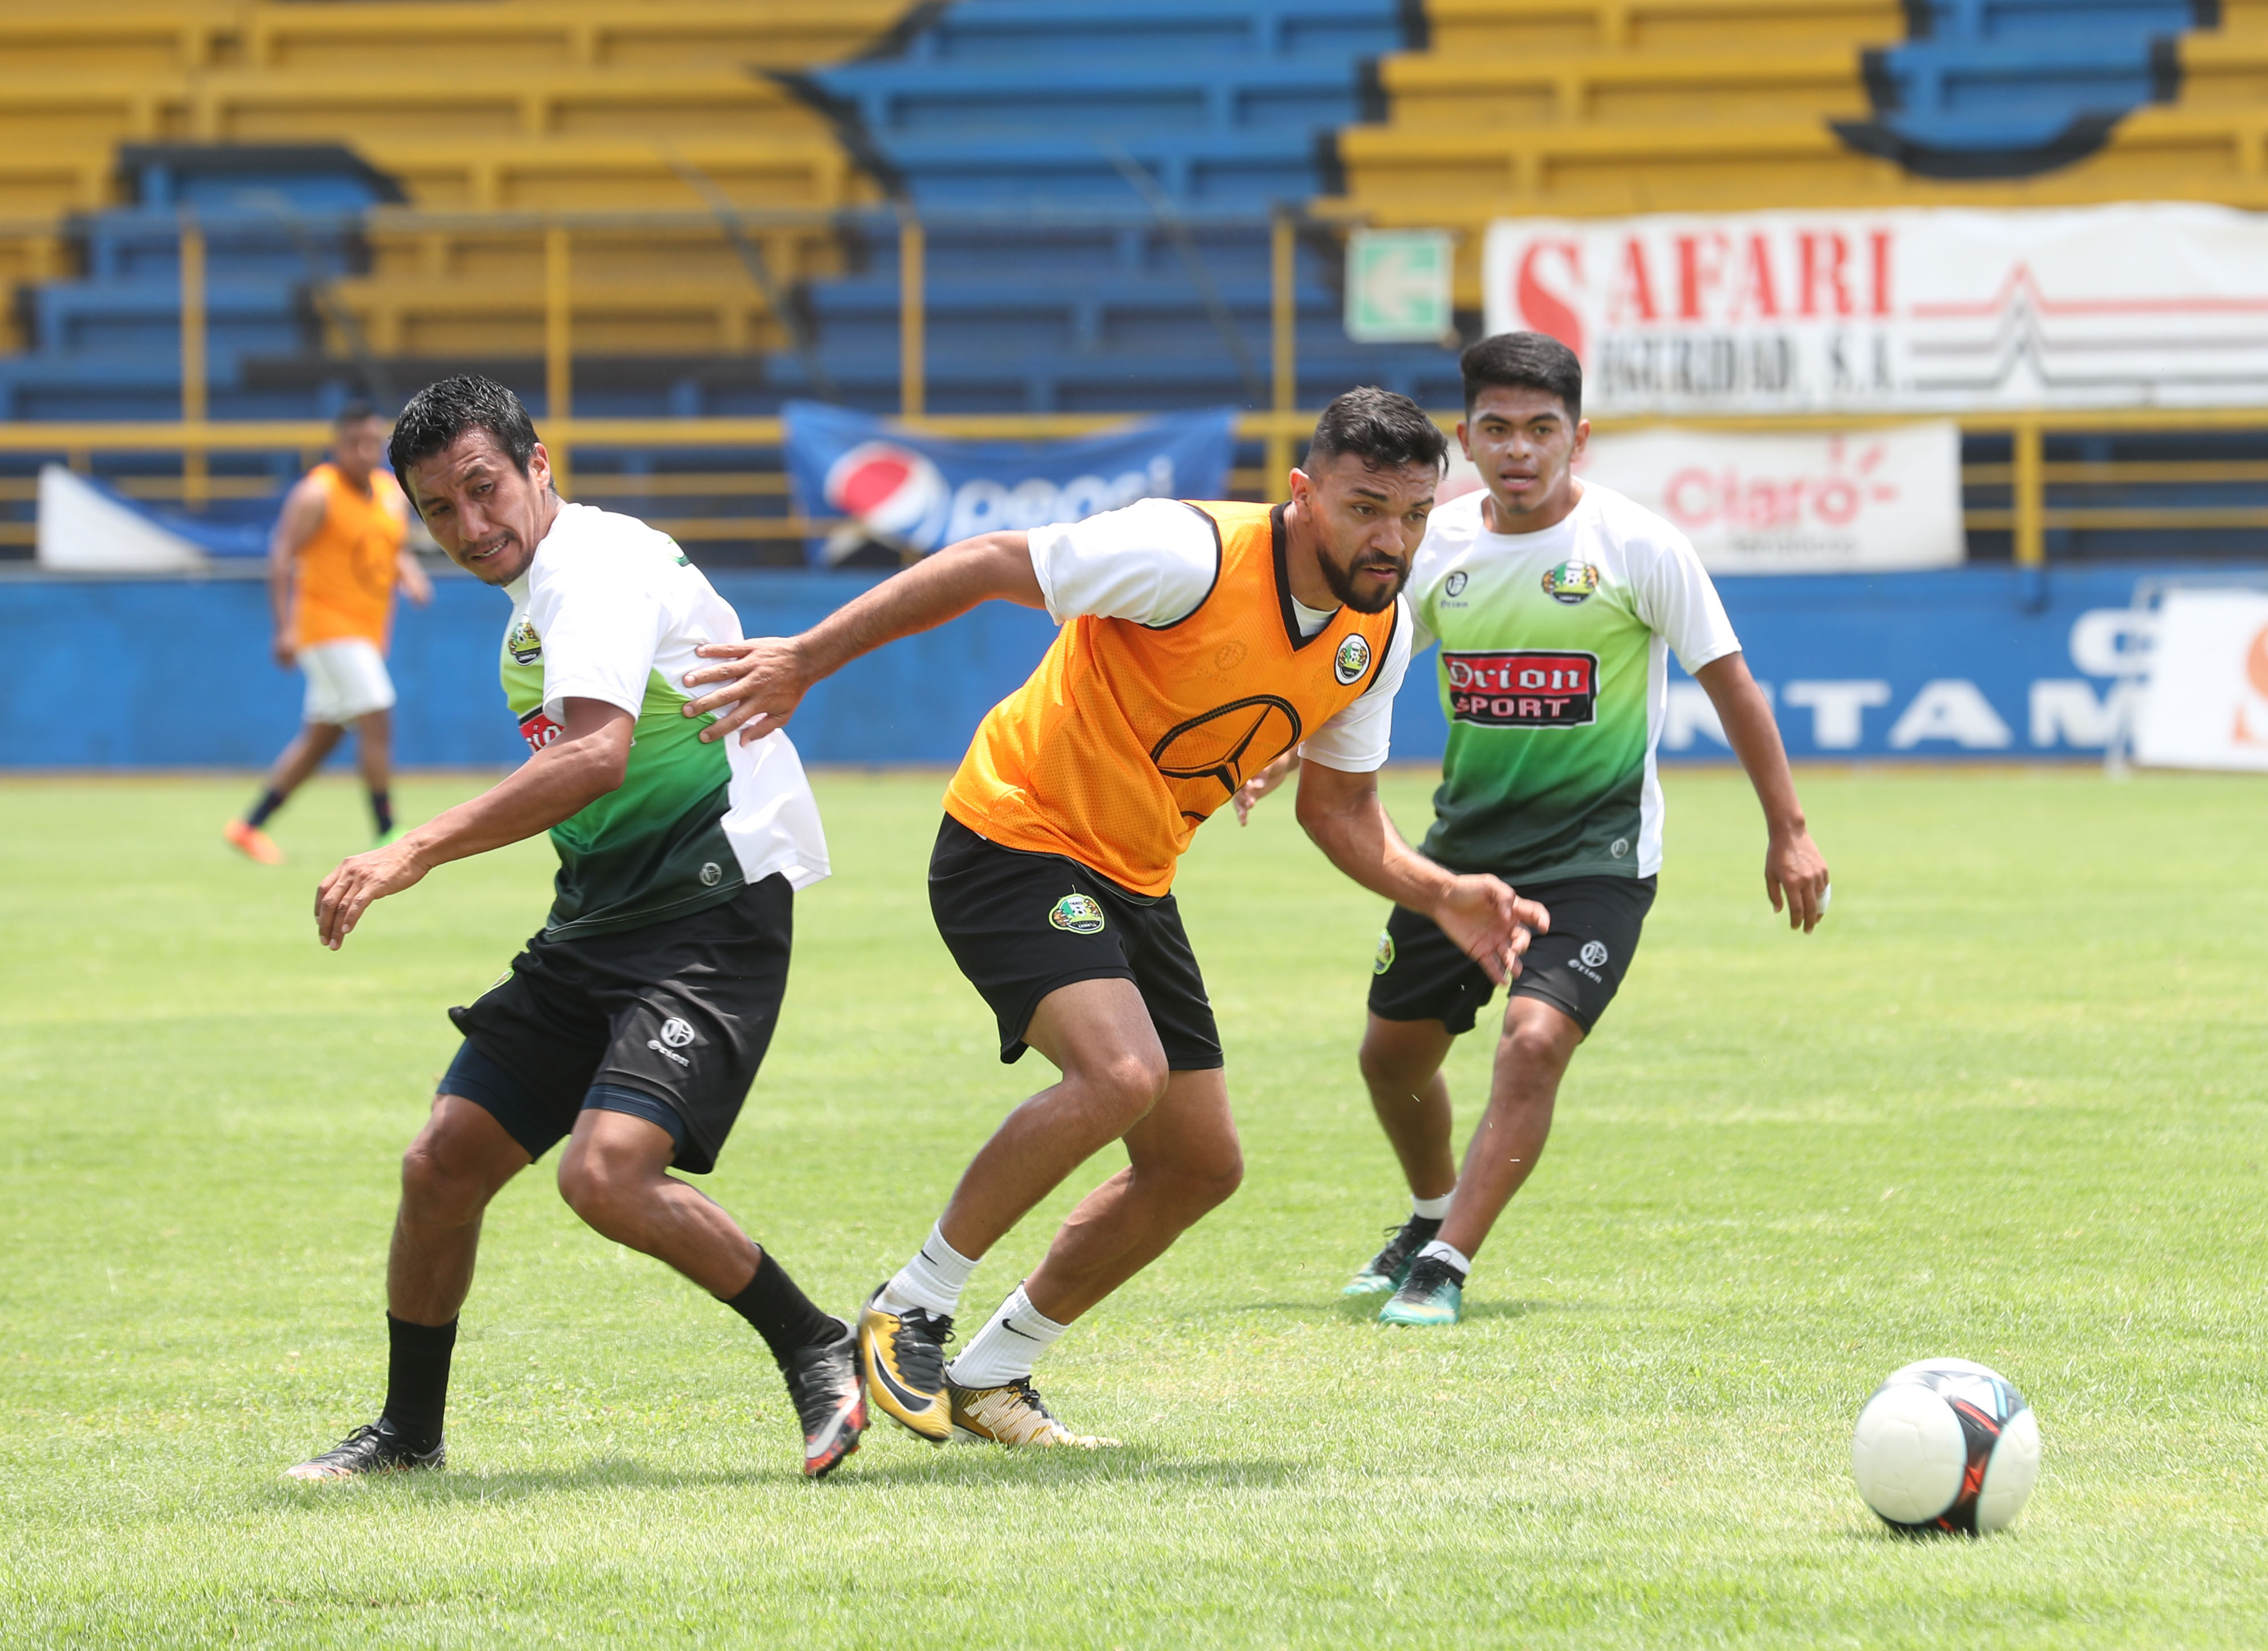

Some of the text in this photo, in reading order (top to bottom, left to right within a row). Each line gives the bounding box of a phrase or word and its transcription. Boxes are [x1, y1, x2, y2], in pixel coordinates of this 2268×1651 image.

[1514, 229, 1899, 361] SAFARI
[1663, 464, 1863, 531] Claro
[1450, 661, 1582, 690] Orion
[1455, 695, 1571, 717] SPORT
[1567, 959, 1602, 984] Orion
[646, 1040, 690, 1067] Orion
